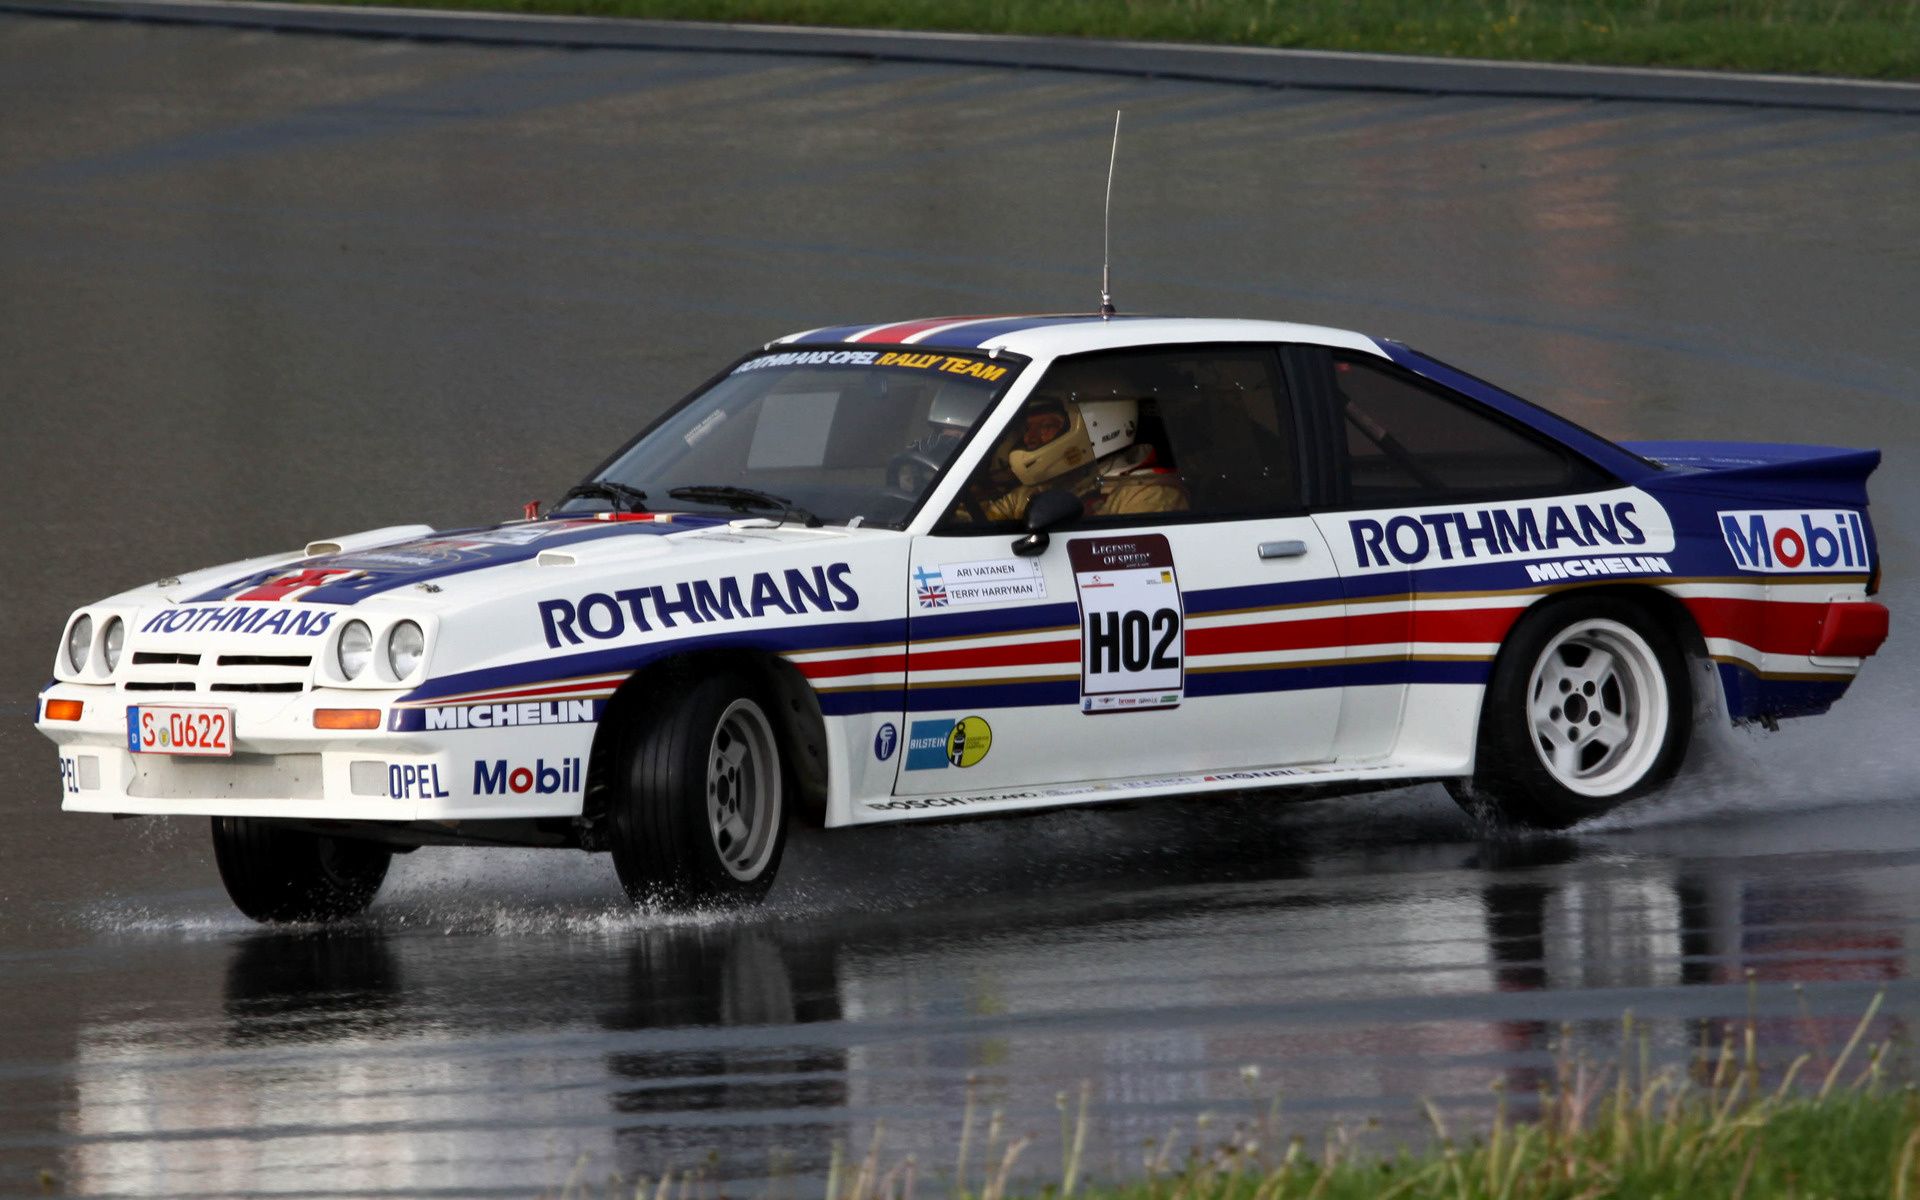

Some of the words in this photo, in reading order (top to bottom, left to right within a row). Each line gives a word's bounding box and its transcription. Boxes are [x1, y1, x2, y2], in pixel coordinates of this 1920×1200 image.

[828, 350, 880, 365] OPEL
[873, 351, 941, 369] RALLY
[938, 356, 1009, 382] TEAM
[1347, 501, 1647, 569] ROTHMANS
[1721, 513, 1868, 570] Mobil
[956, 568, 973, 578] ARI
[972, 565, 1016, 576] VATANEN
[1103, 556, 1117, 566] OF
[1525, 556, 1673, 583] MICHELIN
[537, 562, 860, 649] ROTHMANS
[950, 588, 981, 600] TERRY
[981, 585, 1034, 597] HARRYMAN
[140, 606, 338, 637] ROTHMANS
[424, 699, 594, 731] MICHELIN
[909, 737, 947, 750] BILSTEIN
[59, 757, 79, 793] PEL
[388, 763, 450, 799] OPEL
[473, 757, 580, 795] Mobil
[866, 797, 968, 811] BOSCH
